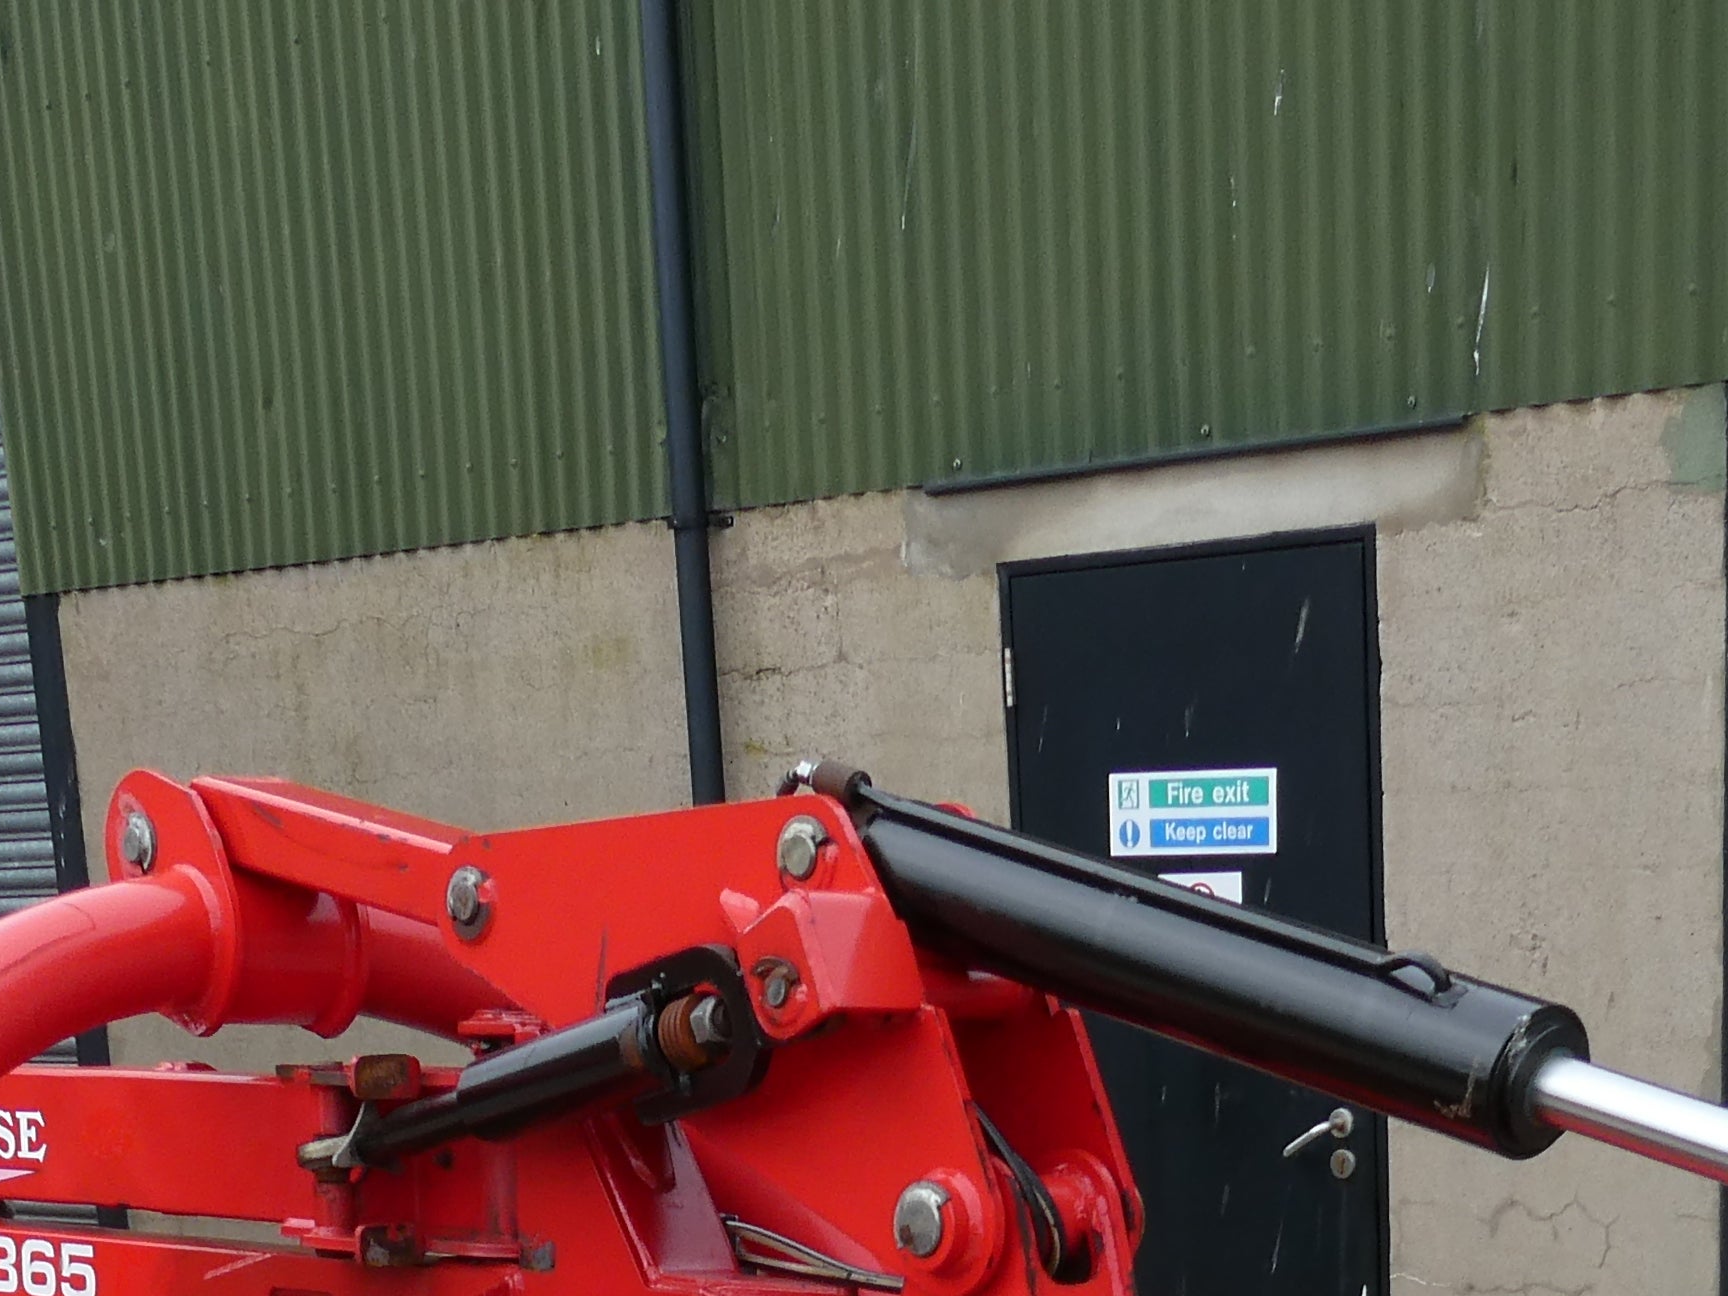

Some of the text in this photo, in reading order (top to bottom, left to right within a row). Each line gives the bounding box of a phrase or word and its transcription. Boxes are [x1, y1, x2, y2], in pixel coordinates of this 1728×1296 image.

[1167, 780, 1250, 804] Fire exit
[1165, 820, 1253, 844] Keep clear
